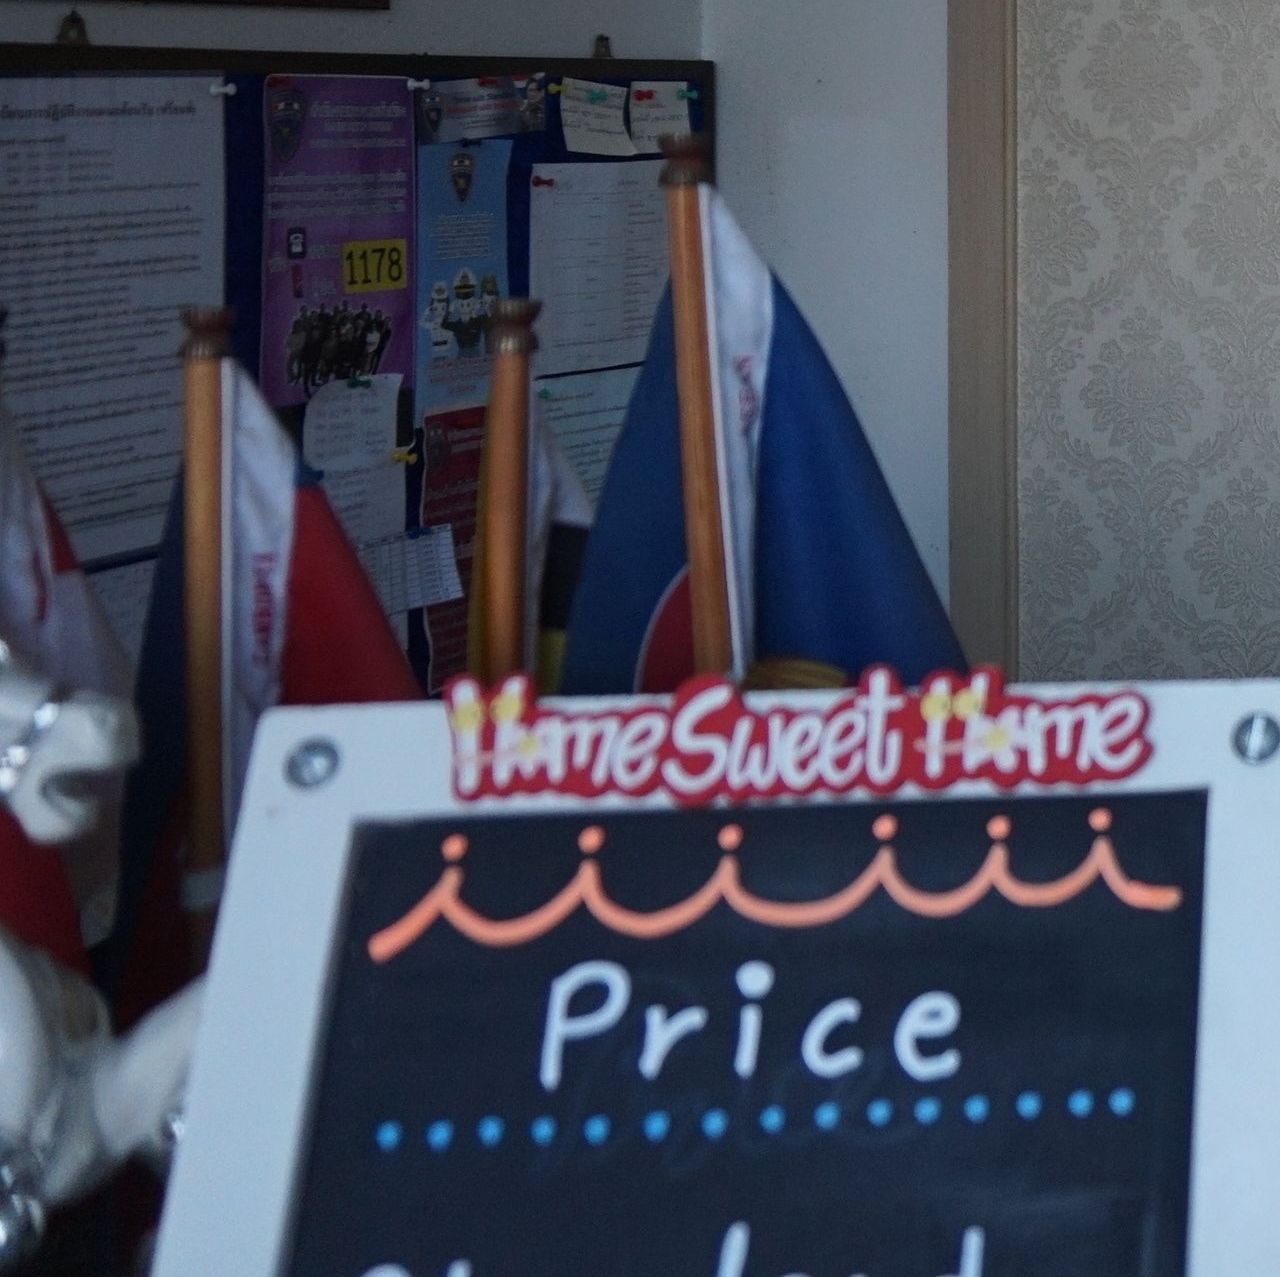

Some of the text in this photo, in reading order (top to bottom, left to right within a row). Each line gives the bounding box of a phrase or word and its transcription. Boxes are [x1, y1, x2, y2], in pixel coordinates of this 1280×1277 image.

[345, 246, 403, 286] 1178
[450, 666, 1146, 797] Home Sweet Home
[538, 959, 964, 1093] Price
